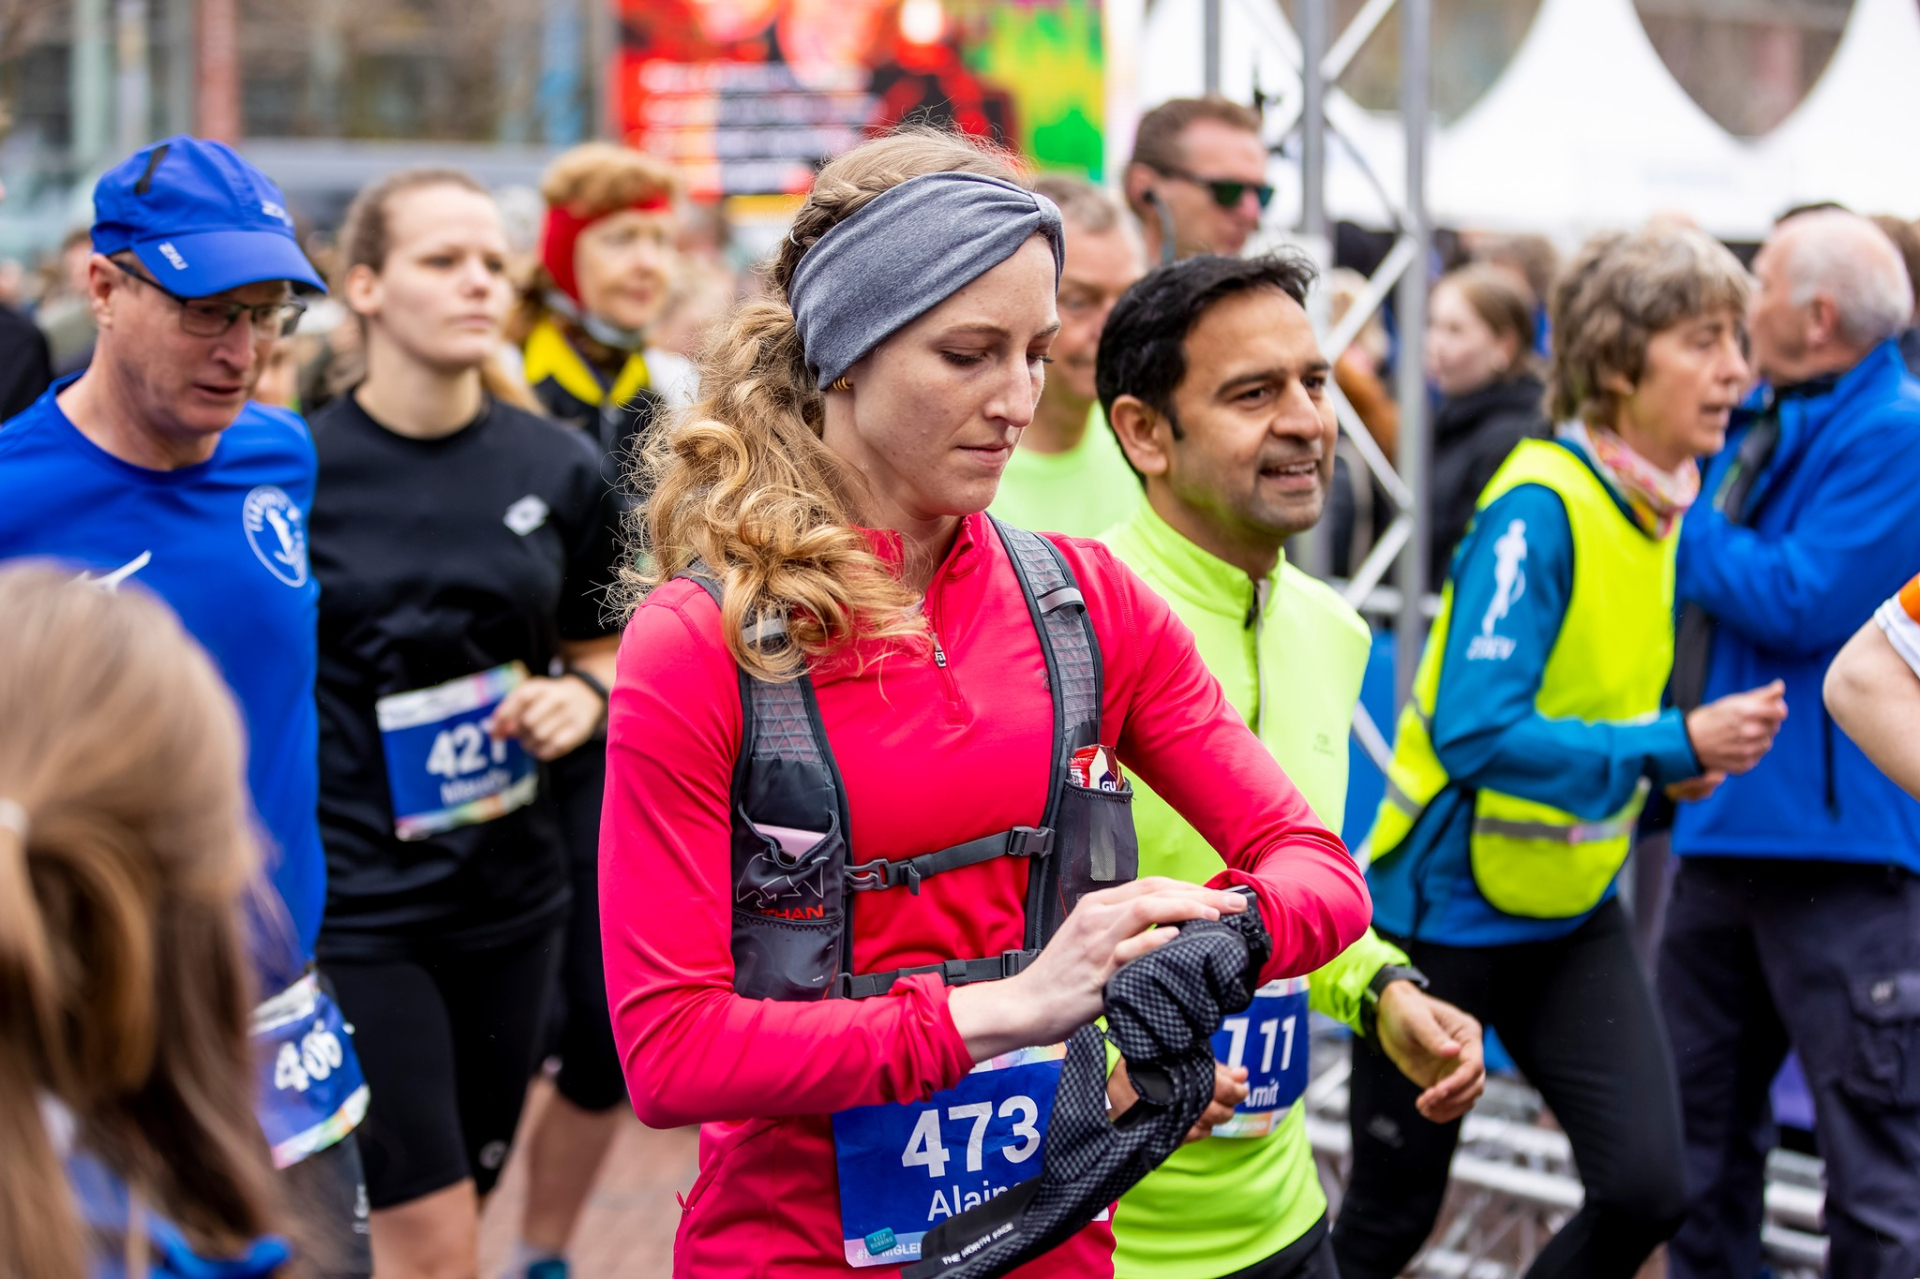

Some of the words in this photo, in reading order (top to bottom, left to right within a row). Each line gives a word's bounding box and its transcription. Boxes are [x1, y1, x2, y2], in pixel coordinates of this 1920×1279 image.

[901, 1095, 1042, 1179] 473
[942, 1252, 961, 1265] THE
[960, 1234, 991, 1258] NORTH
[992, 1221, 1015, 1240] FACE
